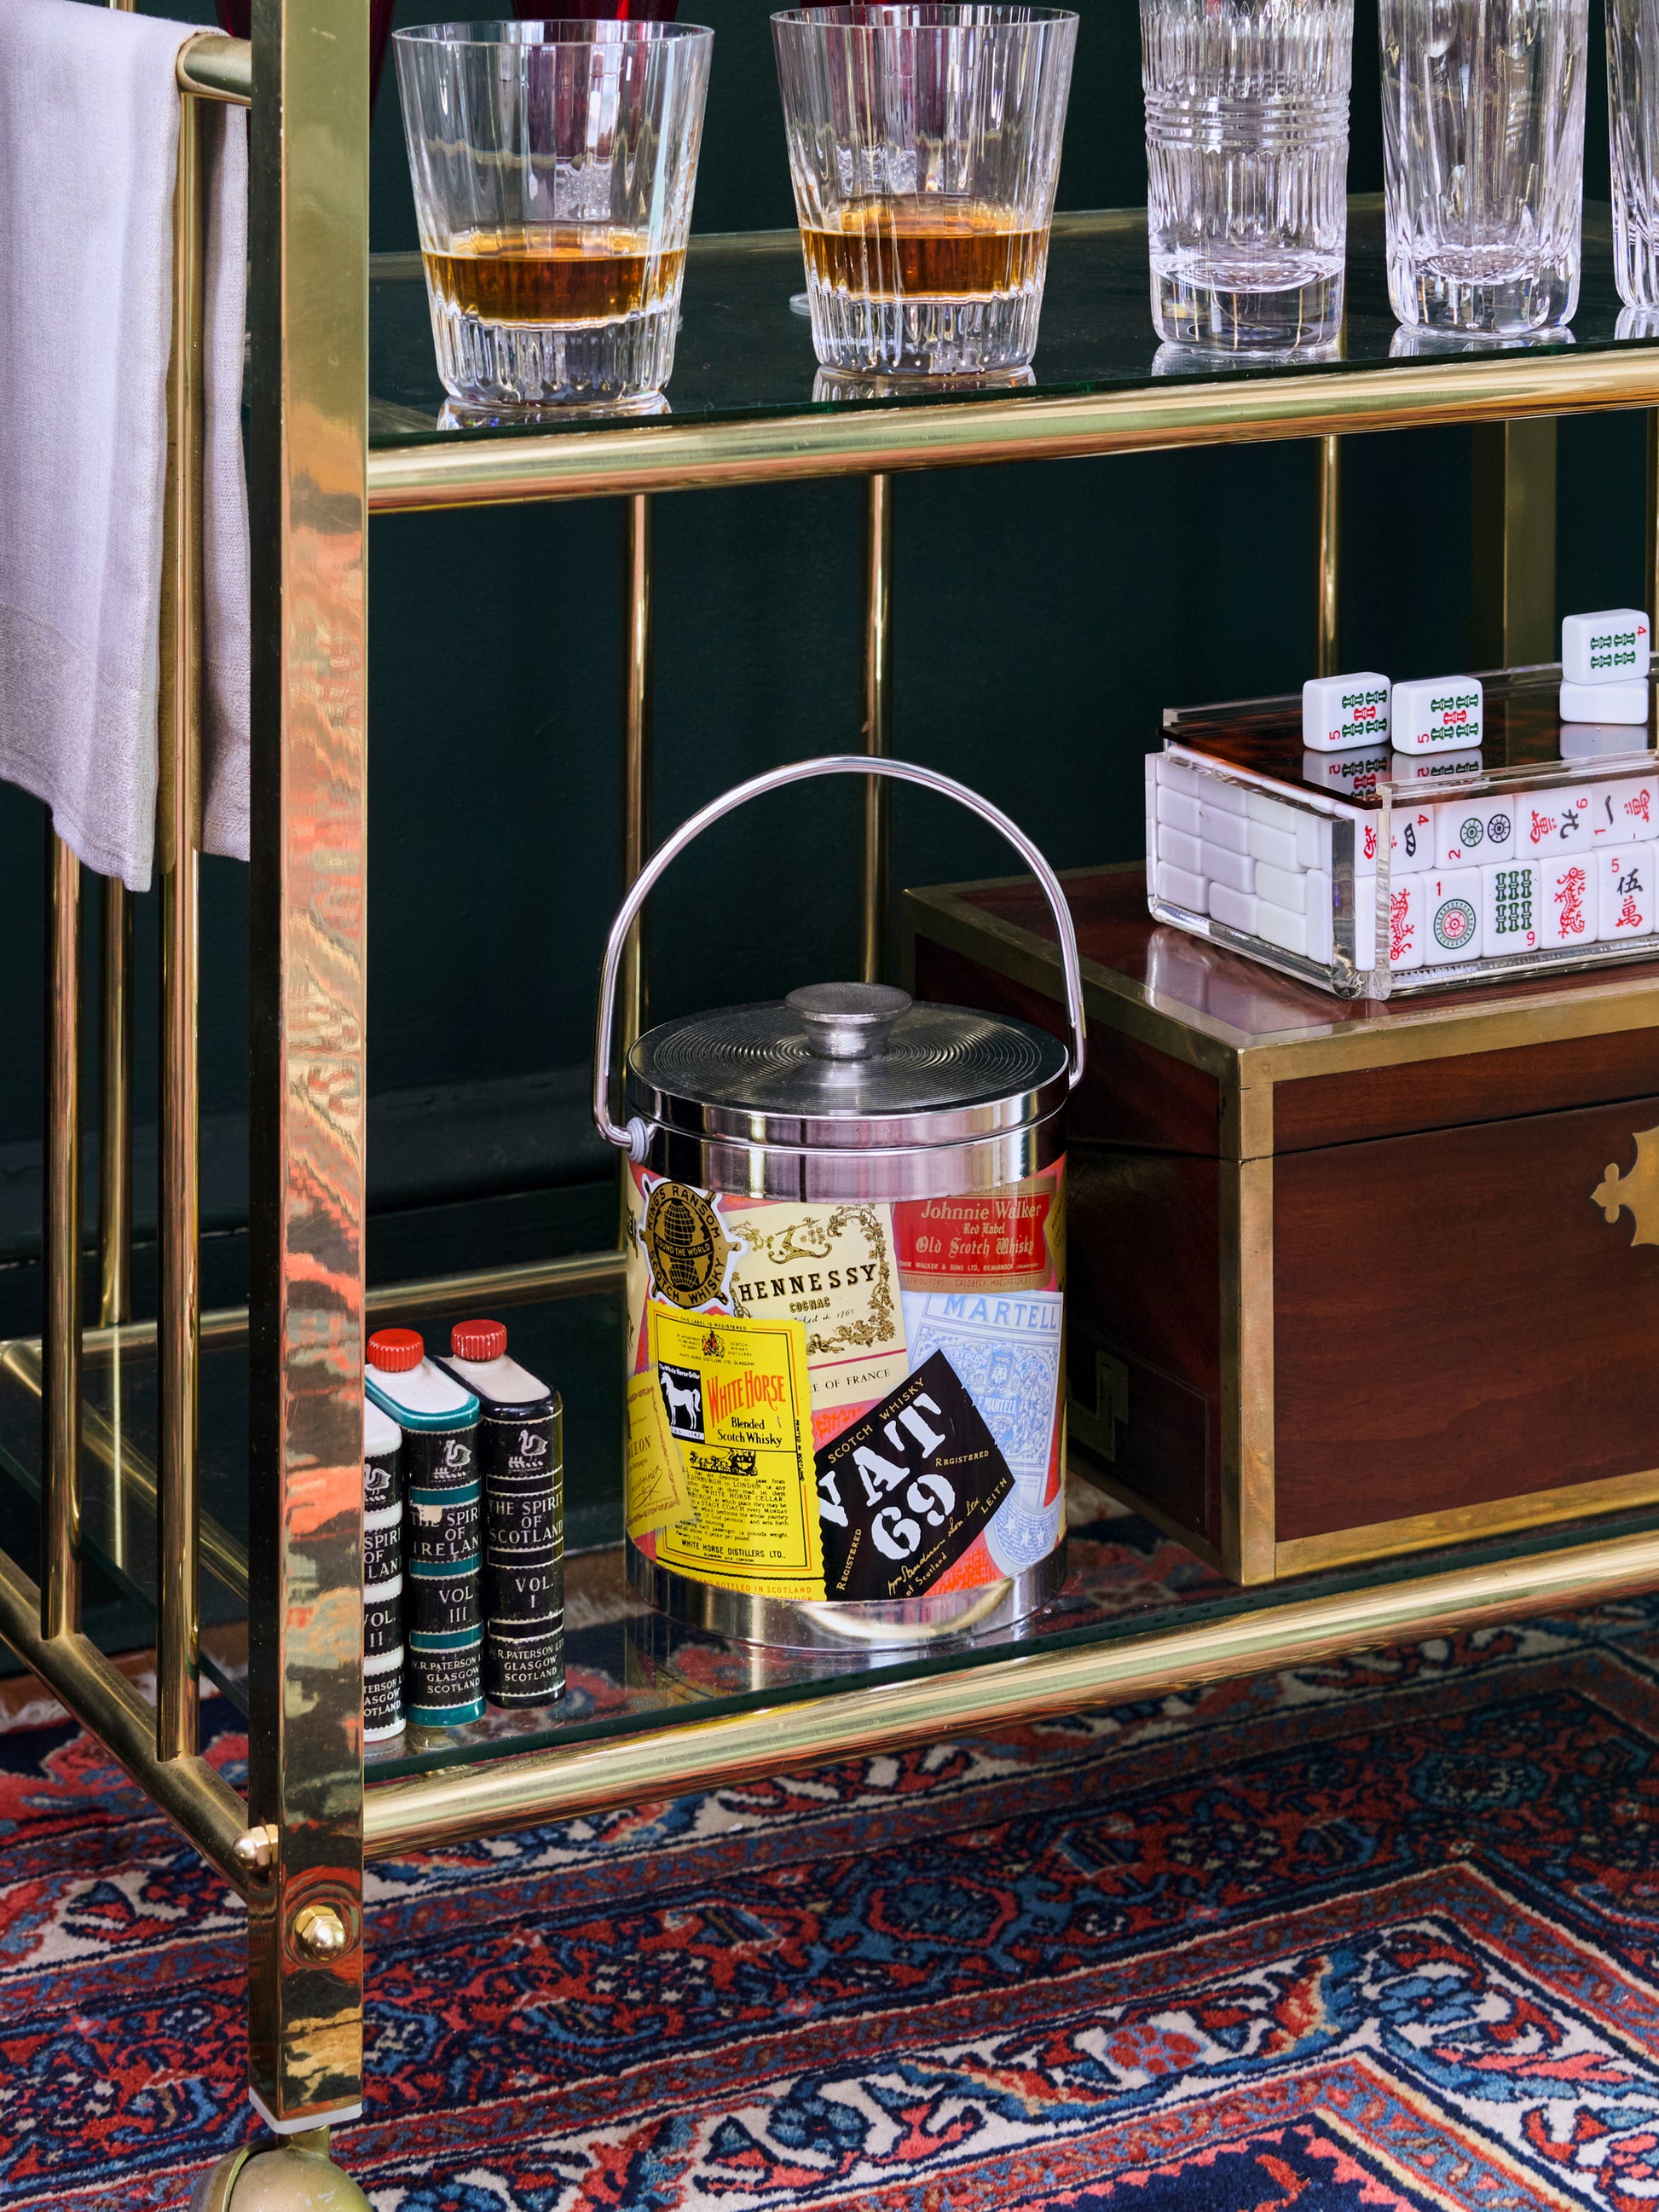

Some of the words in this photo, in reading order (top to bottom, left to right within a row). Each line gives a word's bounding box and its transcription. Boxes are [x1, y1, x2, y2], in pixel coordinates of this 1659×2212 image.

[1636, 625, 1647, 636] 4
[1329, 730, 1341, 740] 5
[1418, 733, 1429, 744] 5
[1417, 814, 1429, 825] 4
[1448, 849, 1460, 860] 2
[1611, 858, 1620, 873] 5
[1436, 882, 1441, 896] 1
[647, 1187, 666, 1231] KING'S
[672, 1185, 721, 1238] RANSOM
[921, 1200, 989, 1221] Johnnie
[995, 1201, 1042, 1219] Walker
[963, 1223, 980, 1235] Red
[981, 1223, 1006, 1236] Label
[675, 1248, 686, 1257] THE
[687, 1243, 711, 1257] WORLD
[916, 1236, 941, 1254] Old
[948, 1236, 990, 1259] Scotch
[996, 1235, 1035, 1257] Whisky
[648, 1251, 680, 1301] SCOTCH
[688, 1258, 725, 1305] WHISKY
[738, 1264, 877, 1301] HENNESSY
[789, 1296, 830, 1313] COGNAC
[943, 1294, 1057, 1330] MARTELL
[825, 1380, 840, 1390] OF
[847, 1369, 891, 1387] FRANCE
[706, 1375, 744, 1429] WHITE
[743, 1369, 786, 1411] HORSE
[985, 1397, 1016, 1414] MARTELL
[731, 1417, 765, 1430] Blended
[827, 1424, 874, 1465] SCOTCH
[878, 1376, 926, 1421] WHISKY
[718, 1429, 745, 1443] Scotch
[746, 1433, 783, 1448] Whisky
[818, 1392, 946, 1527] VAT
[687, 1474, 721, 1485] EDINBURGH
[489, 1499, 515, 1514] THE
[522, 1491, 564, 1514] SPIRIT
[981, 1477, 1008, 1514] LEITH
[522, 1516, 542, 1529] OF
[871, 1474, 956, 1561] 69
[445, 1526, 465, 1541] OF
[488, 1520, 564, 1543] SCOTLAND
[413, 1535, 481, 1555] IRELAN
[682, 1538, 700, 1550] WHITE
[703, 1543, 723, 1554] HORSE
[728, 1547, 764, 1557] DISTILLERS
[364, 1550, 384, 1564] OF
[836, 1528, 862, 1590] REGISTERED
[905, 1584, 915, 1596] of
[916, 1552, 948, 1585] Scotland
[516, 1577, 554, 1593] VOL.
[716, 1581, 751, 1592] BOTTLED
[767, 1586, 812, 1595] SCOTLAND
[439, 1586, 473, 1604] VOL
[530, 1595, 535, 1608] I
[449, 1607, 467, 1624] III
[370, 1631, 384, 1647] II
[505, 1654, 558, 1671] GLASGOW
[426, 1666, 479, 1682] GLASGOW
[505, 1666, 558, 1682] SCOTLAND
[427, 1677, 481, 1694] SCOTLAND
[365, 1688, 401, 1705] ASGOW
[365, 1700, 401, 1717] OTLAND
